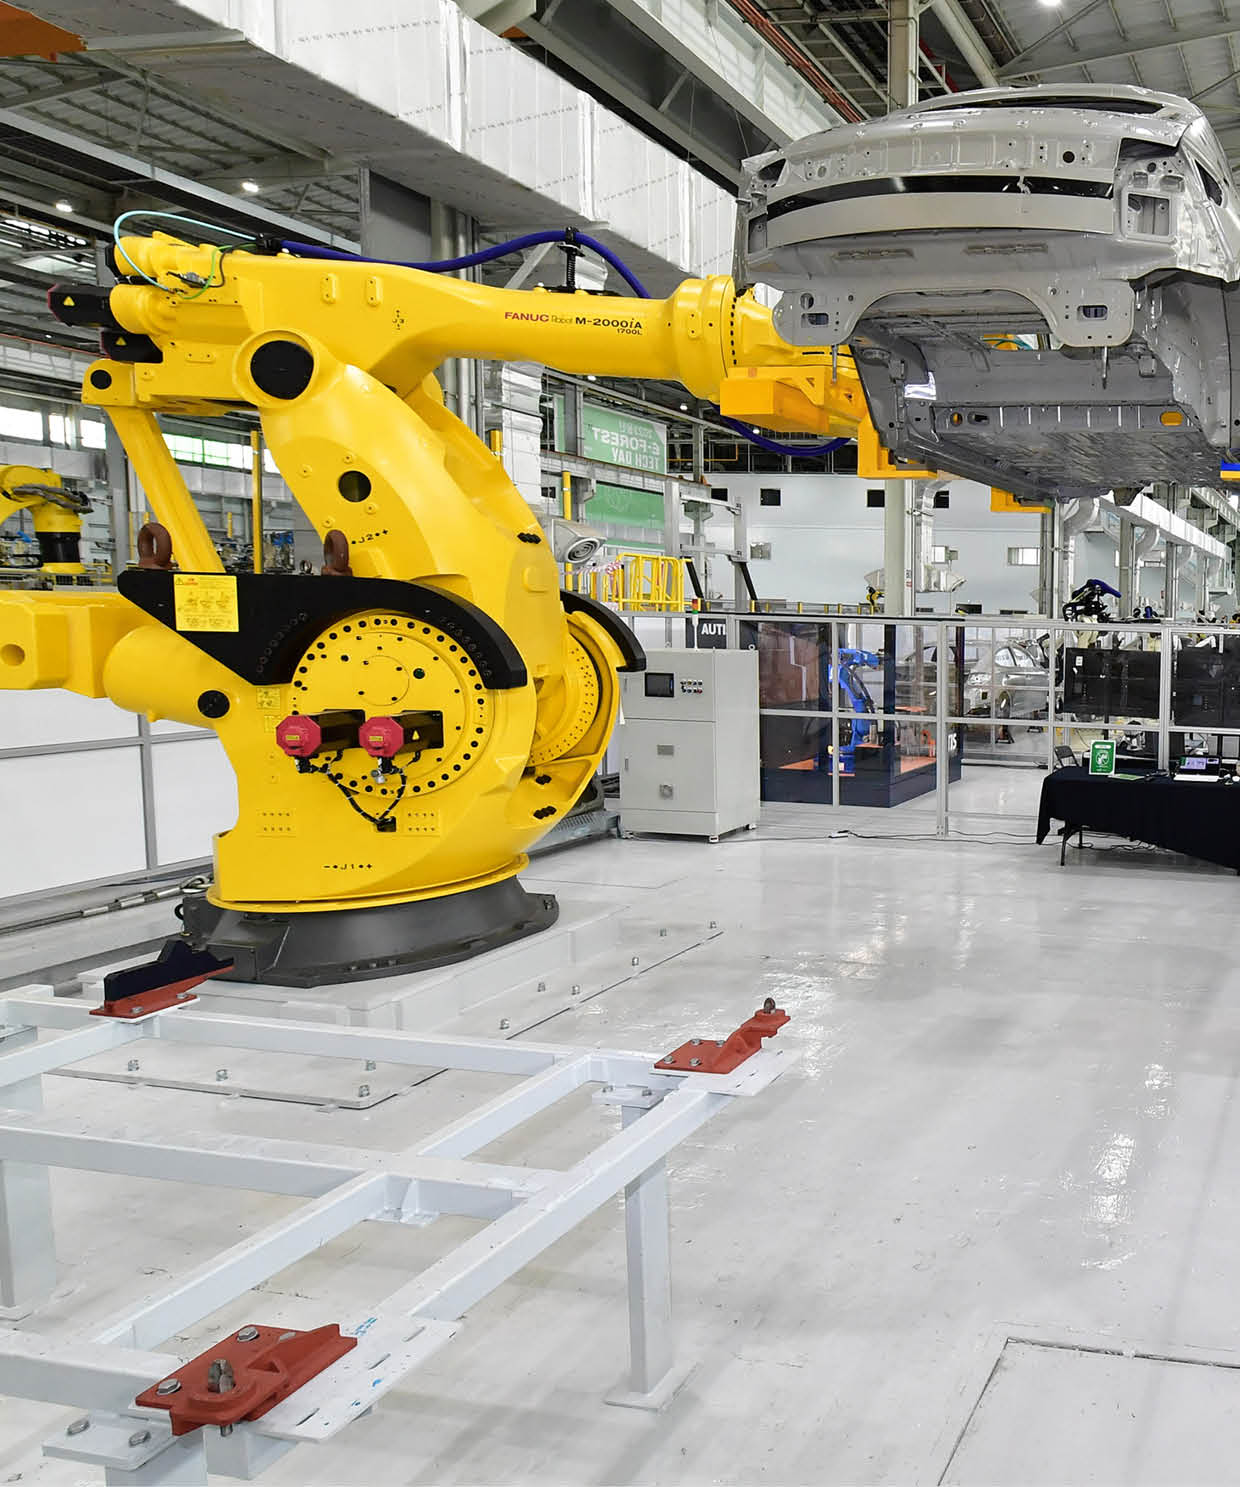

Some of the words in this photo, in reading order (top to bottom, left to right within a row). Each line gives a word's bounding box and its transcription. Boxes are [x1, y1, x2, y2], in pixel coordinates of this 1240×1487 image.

[504, 311, 549, 322] FANUC
[551, 314, 574, 325] Robot
[575, 316, 643, 329] M-2000iA
[616, 328, 643, 336] 1700L
